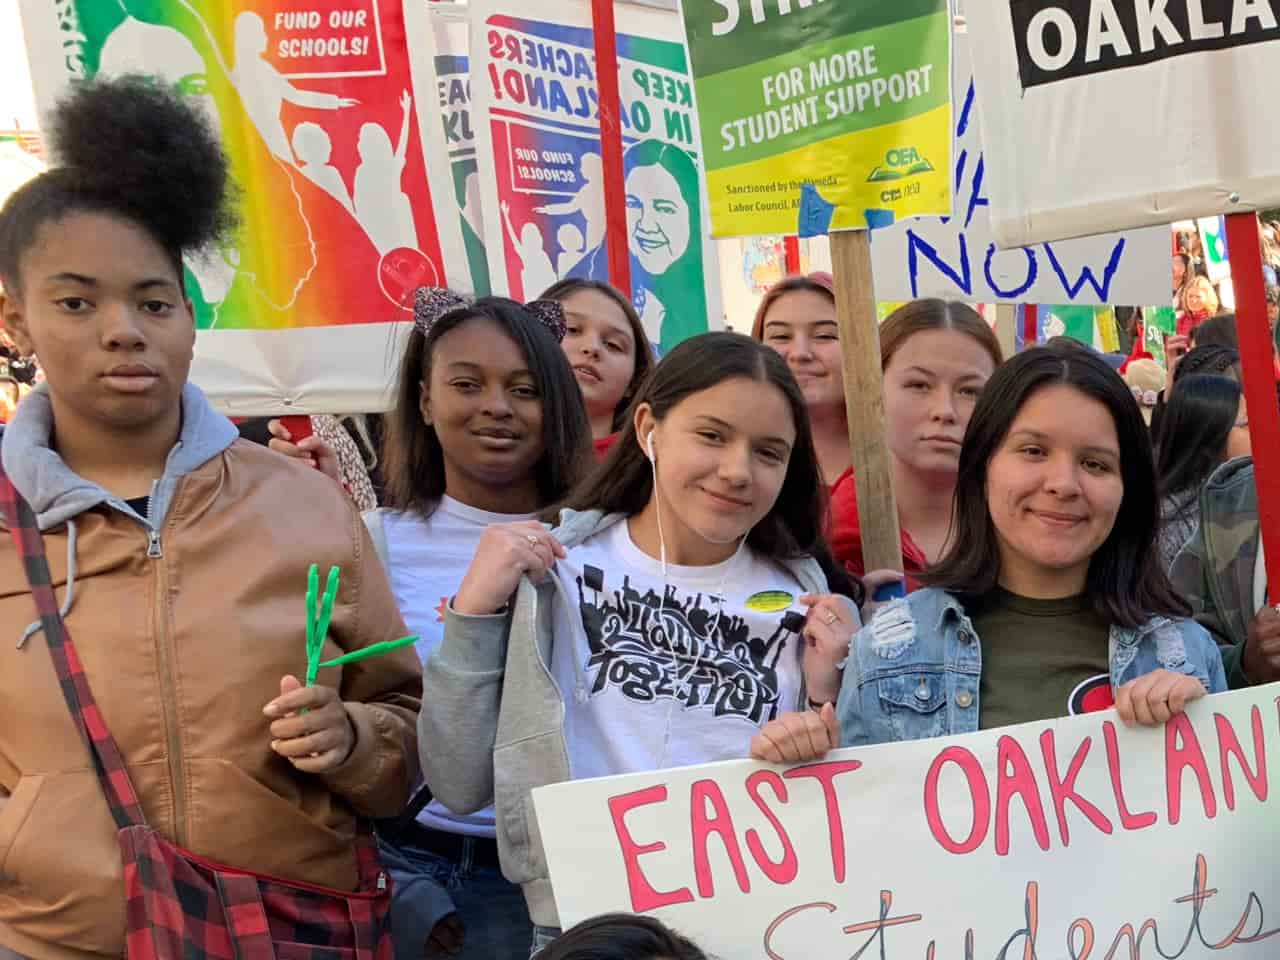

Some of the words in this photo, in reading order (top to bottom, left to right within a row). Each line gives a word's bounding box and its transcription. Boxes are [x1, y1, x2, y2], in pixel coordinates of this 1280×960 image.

[274, 10, 321, 31] FUND
[328, 9, 367, 29] OUR
[278, 36, 369, 59] SCHOOLS!
[761, 66, 804, 106] FOR
[808, 45, 879, 92] MORE
[720, 96, 819, 153] STUDENT
[824, 64, 933, 120] SUPPORT
[886, 147, 920, 167] OEA
[726, 180, 777, 195] Sanctioned
[777, 178, 789, 193] by
[728, 202, 755, 214] Labor
[905, 229, 1127, 303] NOW
[607, 759, 863, 913] EAST
